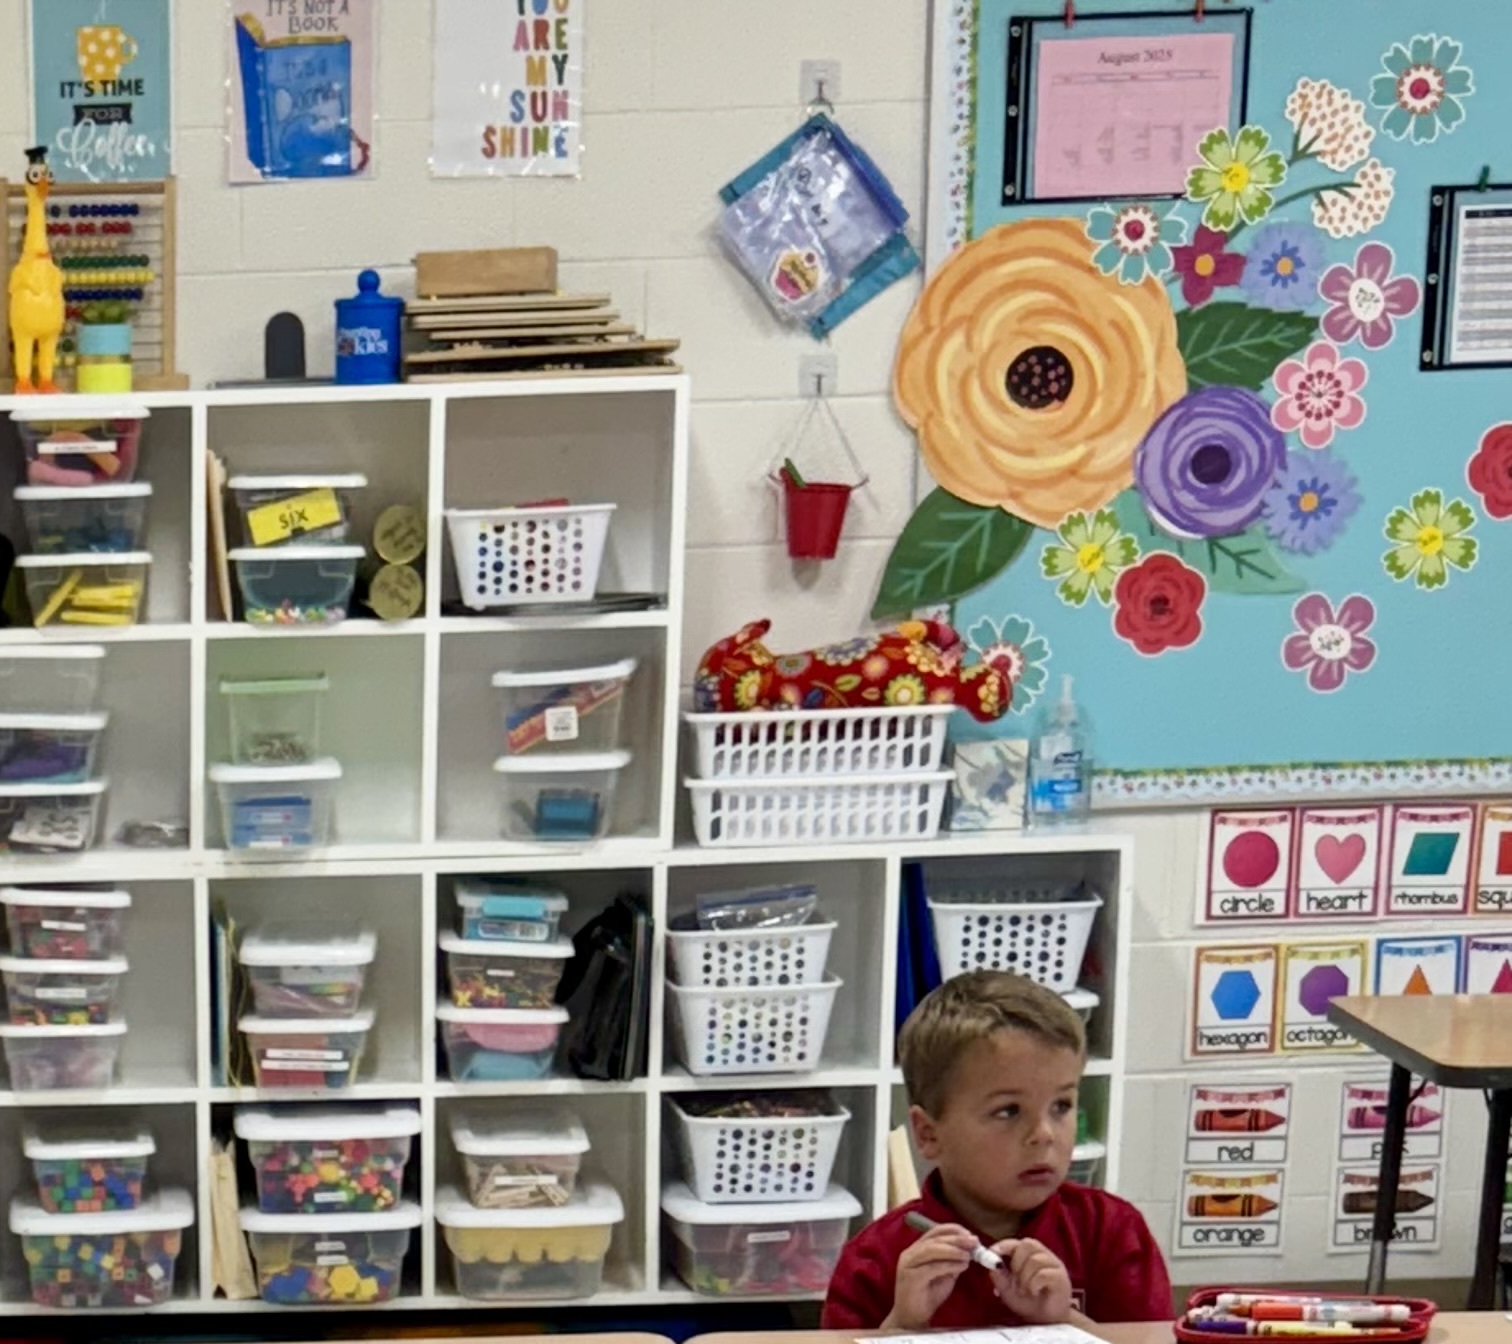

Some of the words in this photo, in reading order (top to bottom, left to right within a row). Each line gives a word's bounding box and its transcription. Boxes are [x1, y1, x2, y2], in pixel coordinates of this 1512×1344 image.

[289, 16, 338, 34] BOOK
[512, 19, 568, 51] ARE
[1097, 50, 1140, 66] August
[525, 53, 568, 86] MY
[60, 80, 95, 98] IT'S
[100, 78, 145, 97] TIME
[510, 90, 569, 123] SUN
[481, 125, 568, 158] SHINE
[1220, 893, 1275, 914] circle
[1306, 893, 1368, 912] heart
[1394, 890, 1458, 905] rhombus
[1199, 1031, 1268, 1051] hexagon
[1217, 1142, 1254, 1161] red
[1193, 1226, 1265, 1246] orange
